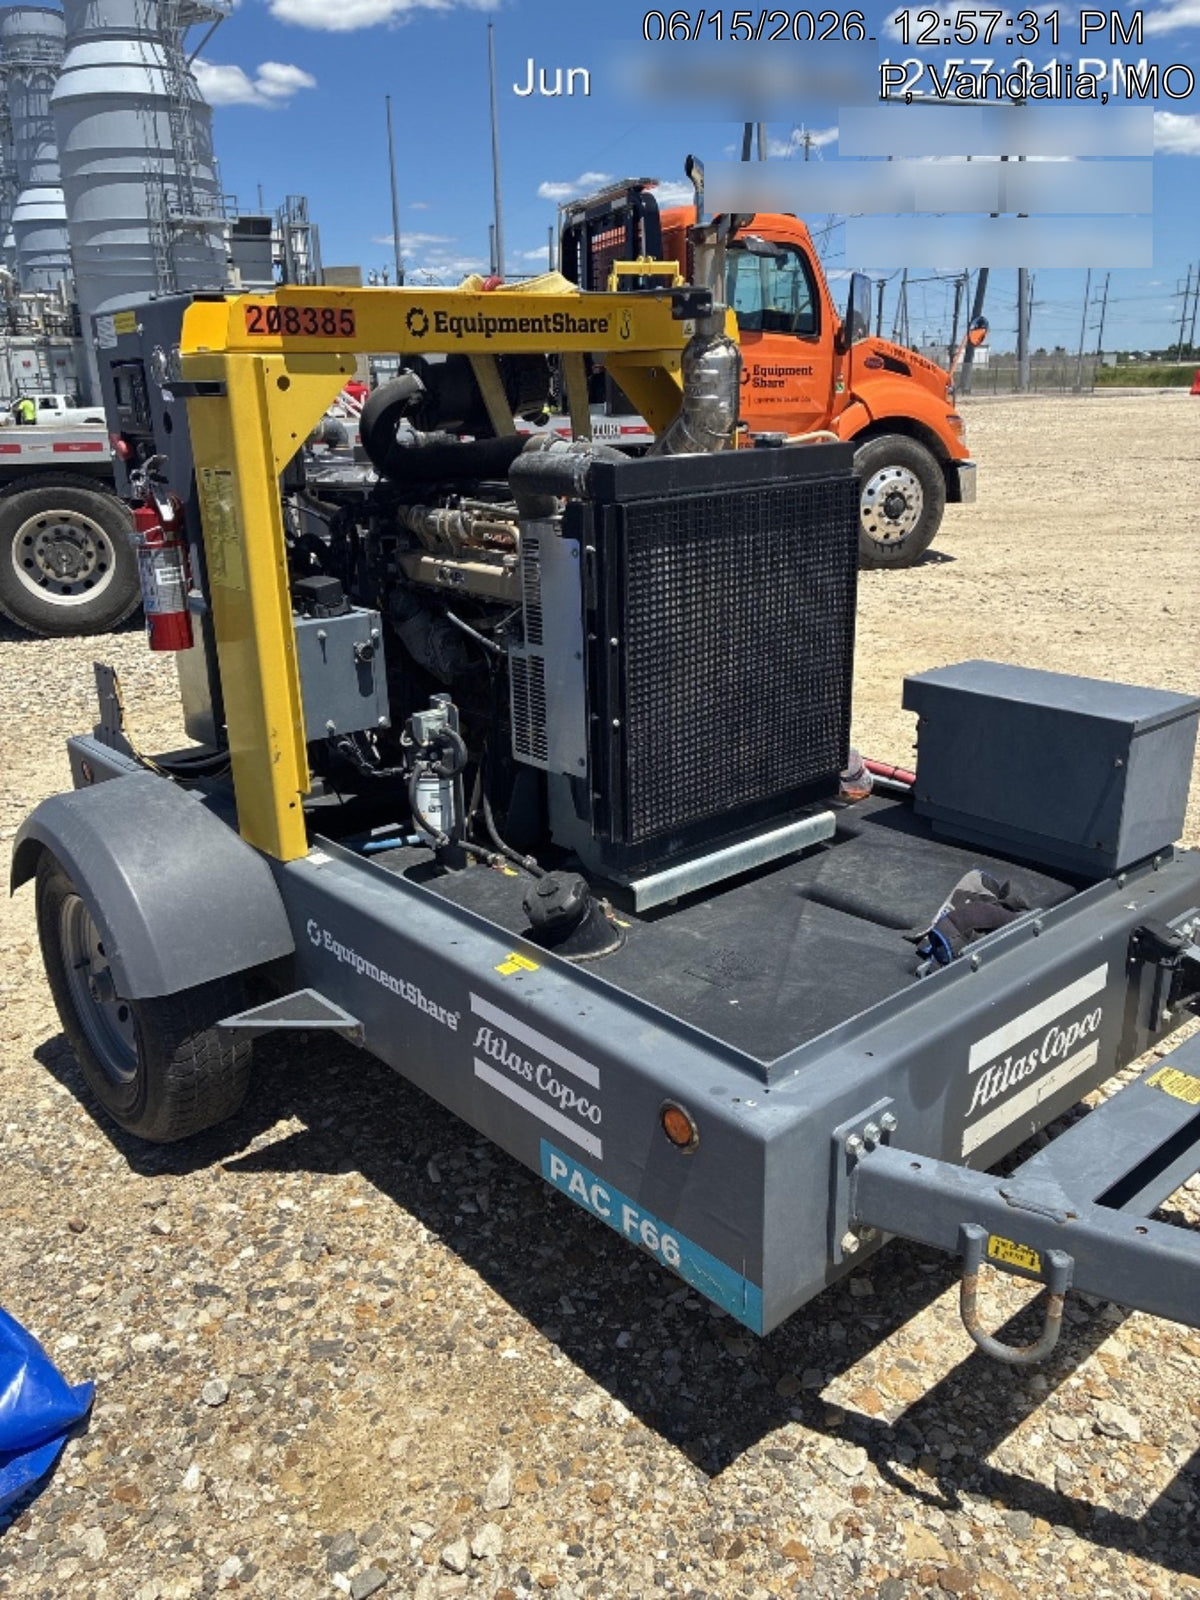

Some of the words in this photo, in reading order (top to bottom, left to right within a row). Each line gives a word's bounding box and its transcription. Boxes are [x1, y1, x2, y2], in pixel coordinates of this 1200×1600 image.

[246, 305, 356, 338] 208385
[434, 311, 609, 339] EquipmentShare
[752, 364, 814, 377] Equipment
[752, 377, 785, 389] Share
[473, 1026, 534, 1082] Atlas
[535, 1063, 603, 1125] Copco
[964, 1048, 1040, 1117] Atlas
[1040, 1007, 1103, 1064] Copco
[549, 1152, 611, 1217] PAC
[622, 1203, 682, 1268] F66
